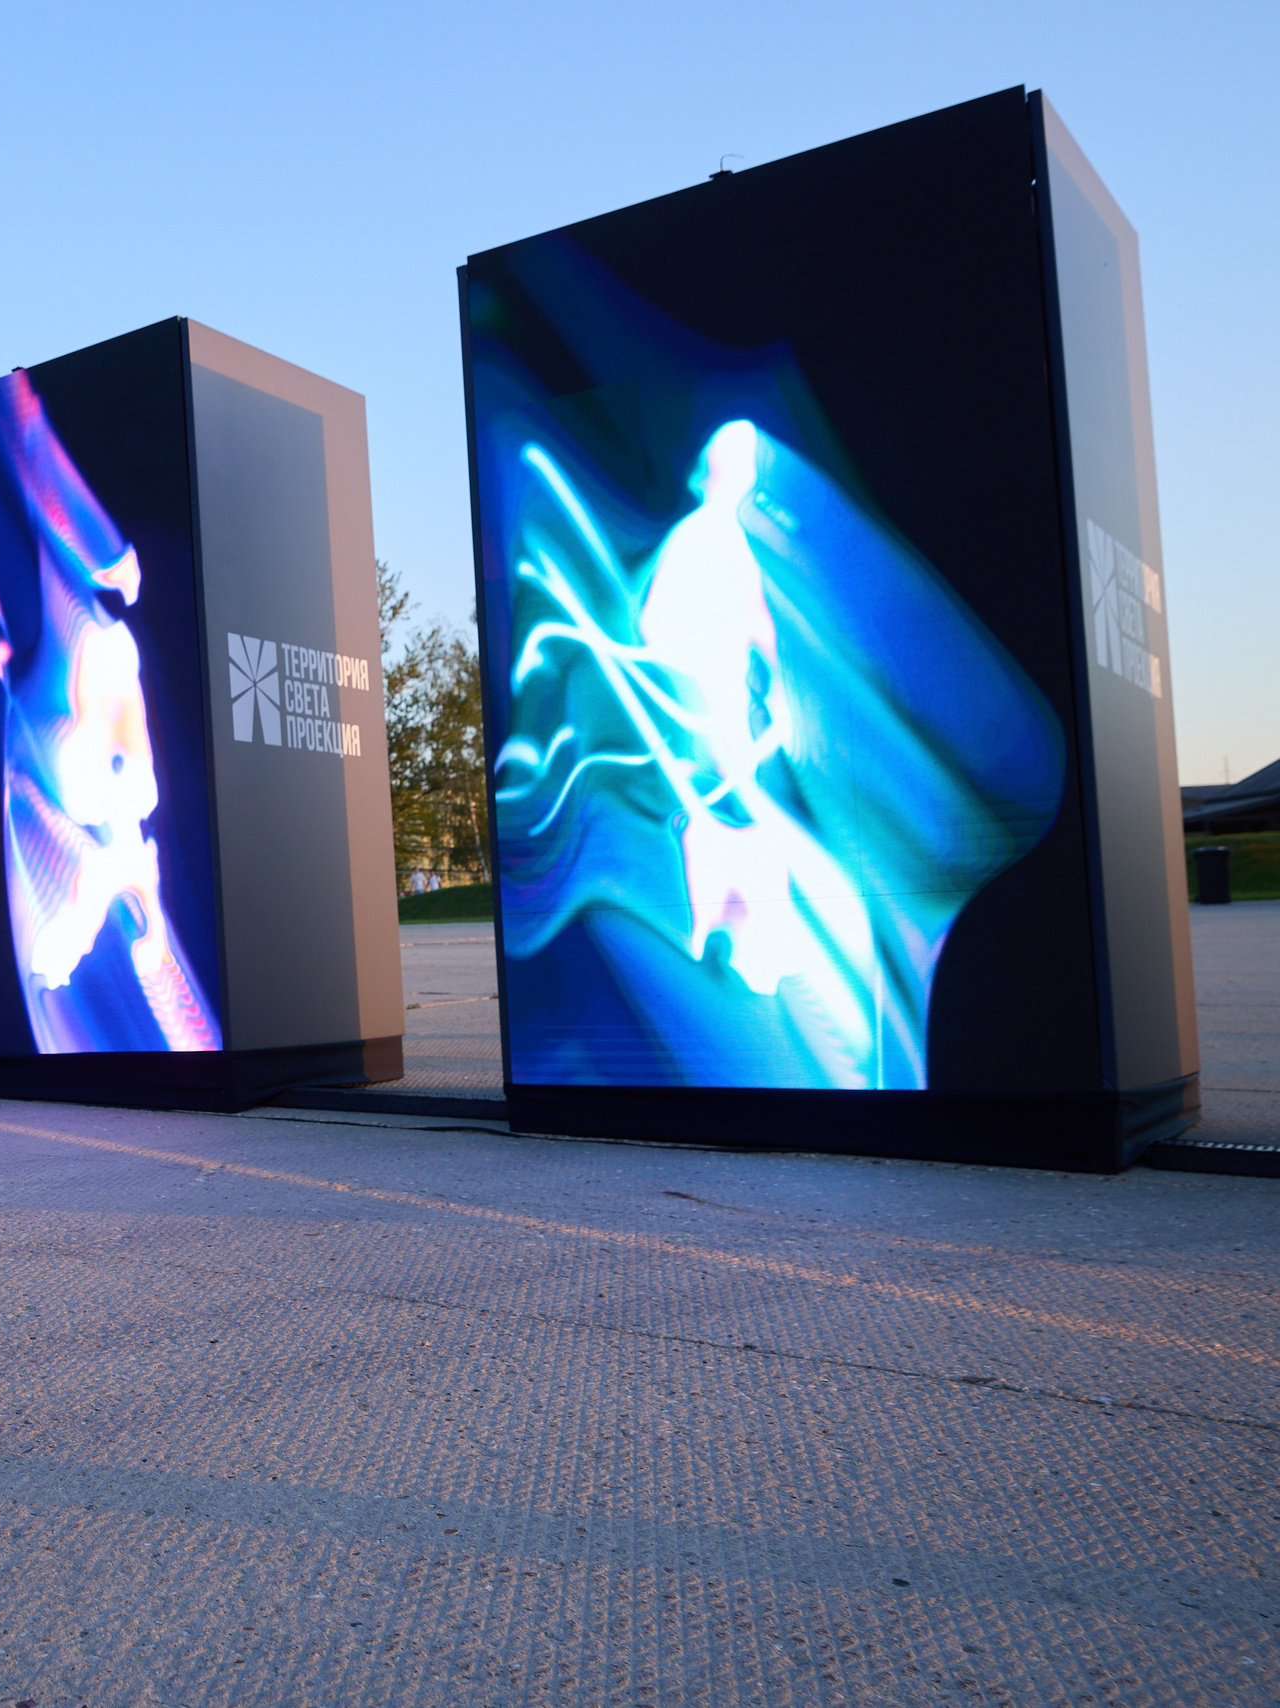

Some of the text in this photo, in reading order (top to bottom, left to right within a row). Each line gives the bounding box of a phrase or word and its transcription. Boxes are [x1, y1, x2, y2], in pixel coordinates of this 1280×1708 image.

[281, 643, 369, 691] ТЕРРИТОРИЯ
[284, 679, 330, 718] СВЕТА
[286, 715, 361, 758] ПРОЕКЦИЯ
